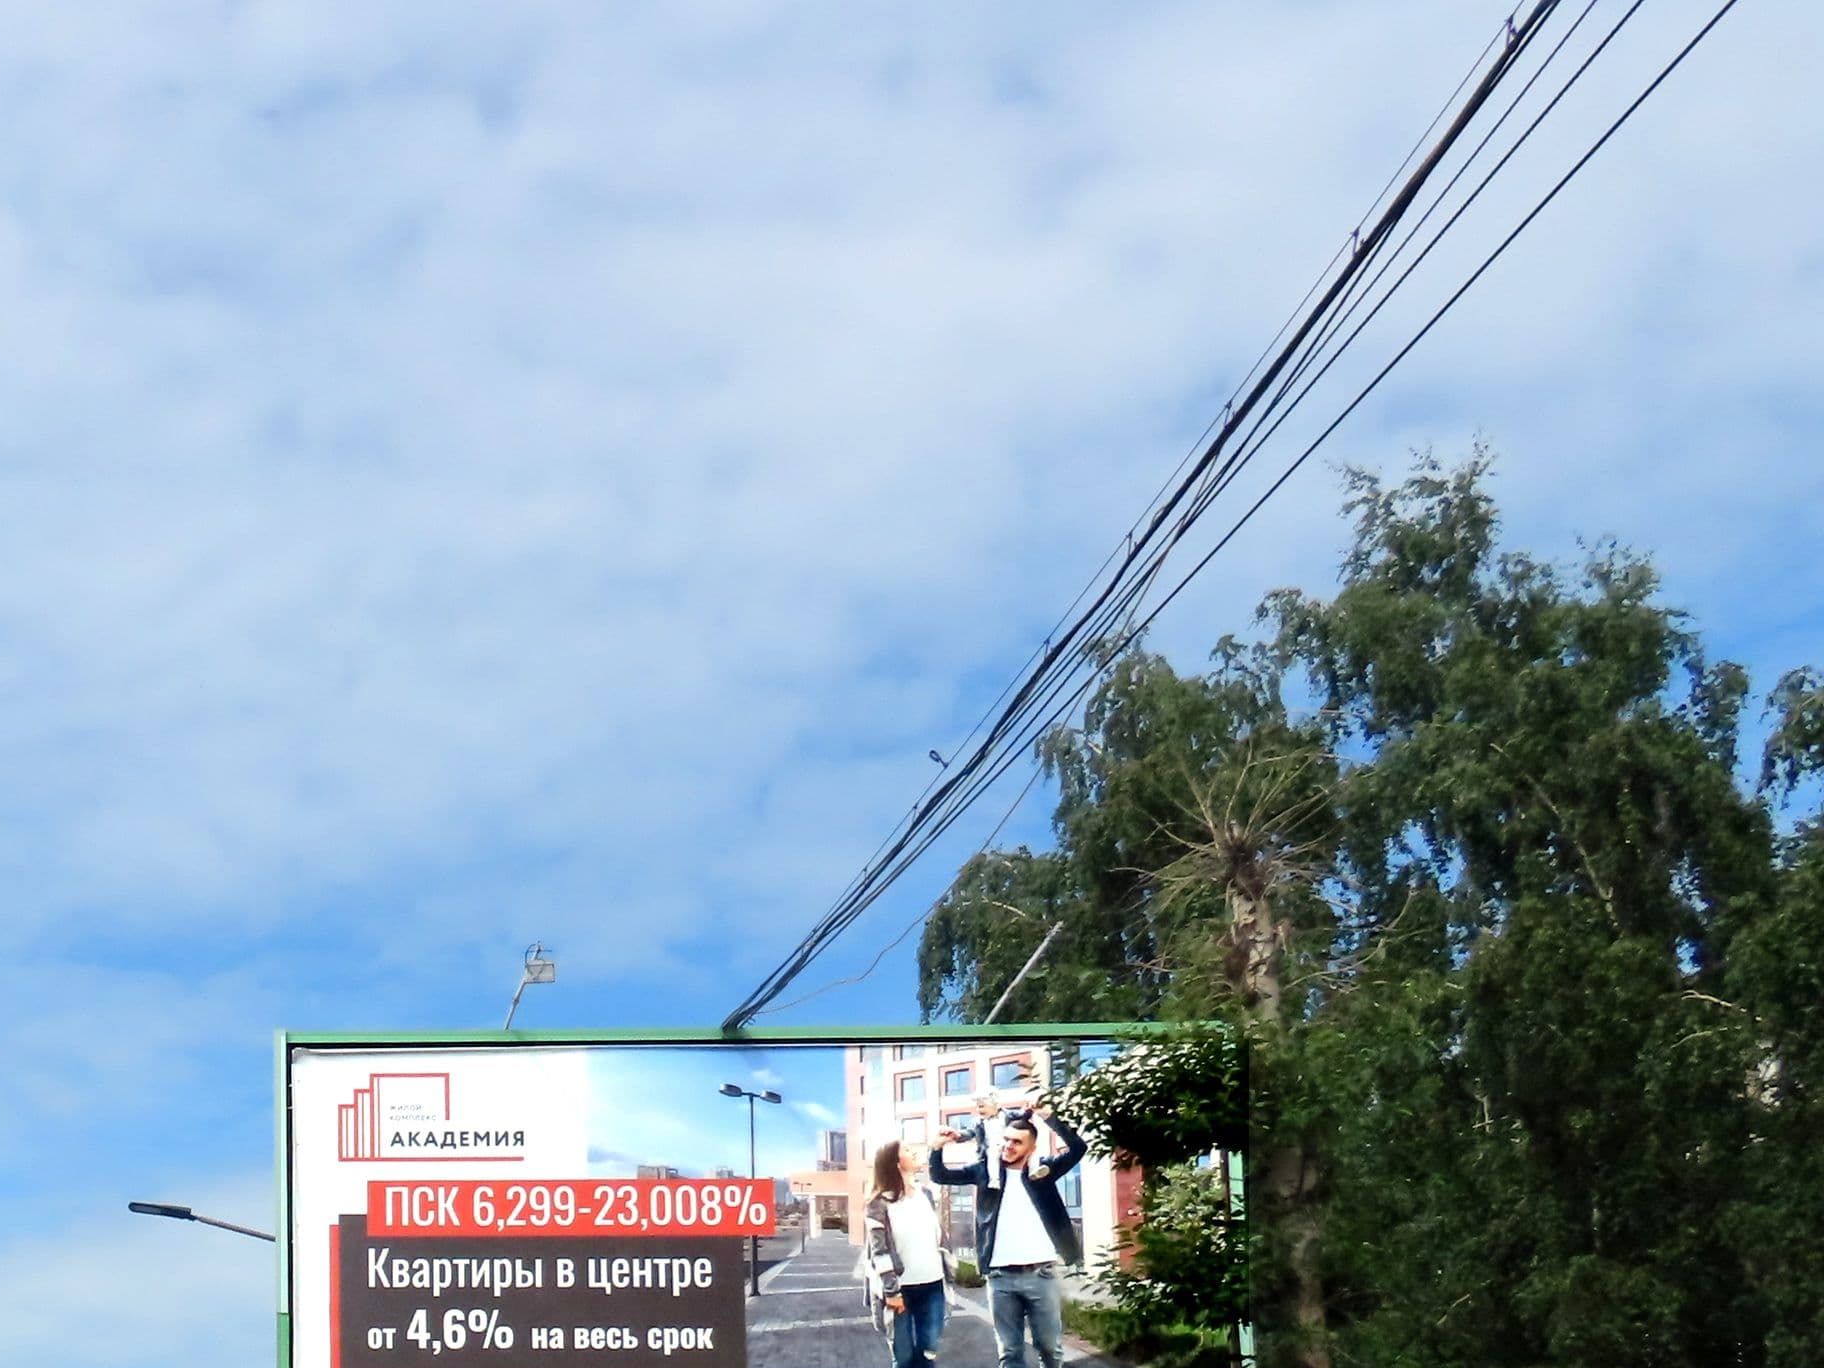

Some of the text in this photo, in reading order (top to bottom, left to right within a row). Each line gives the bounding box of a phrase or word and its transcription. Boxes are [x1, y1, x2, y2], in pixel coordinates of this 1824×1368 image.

[390, 1130, 525, 1149] АКАДЕМИЯ
[384, 1184, 767, 1232] ПСК 6,299-23,008%
[366, 1247, 713, 1297] Квартиры в центре
[367, 1308, 714, 1356] от 4,6% на весь срок
